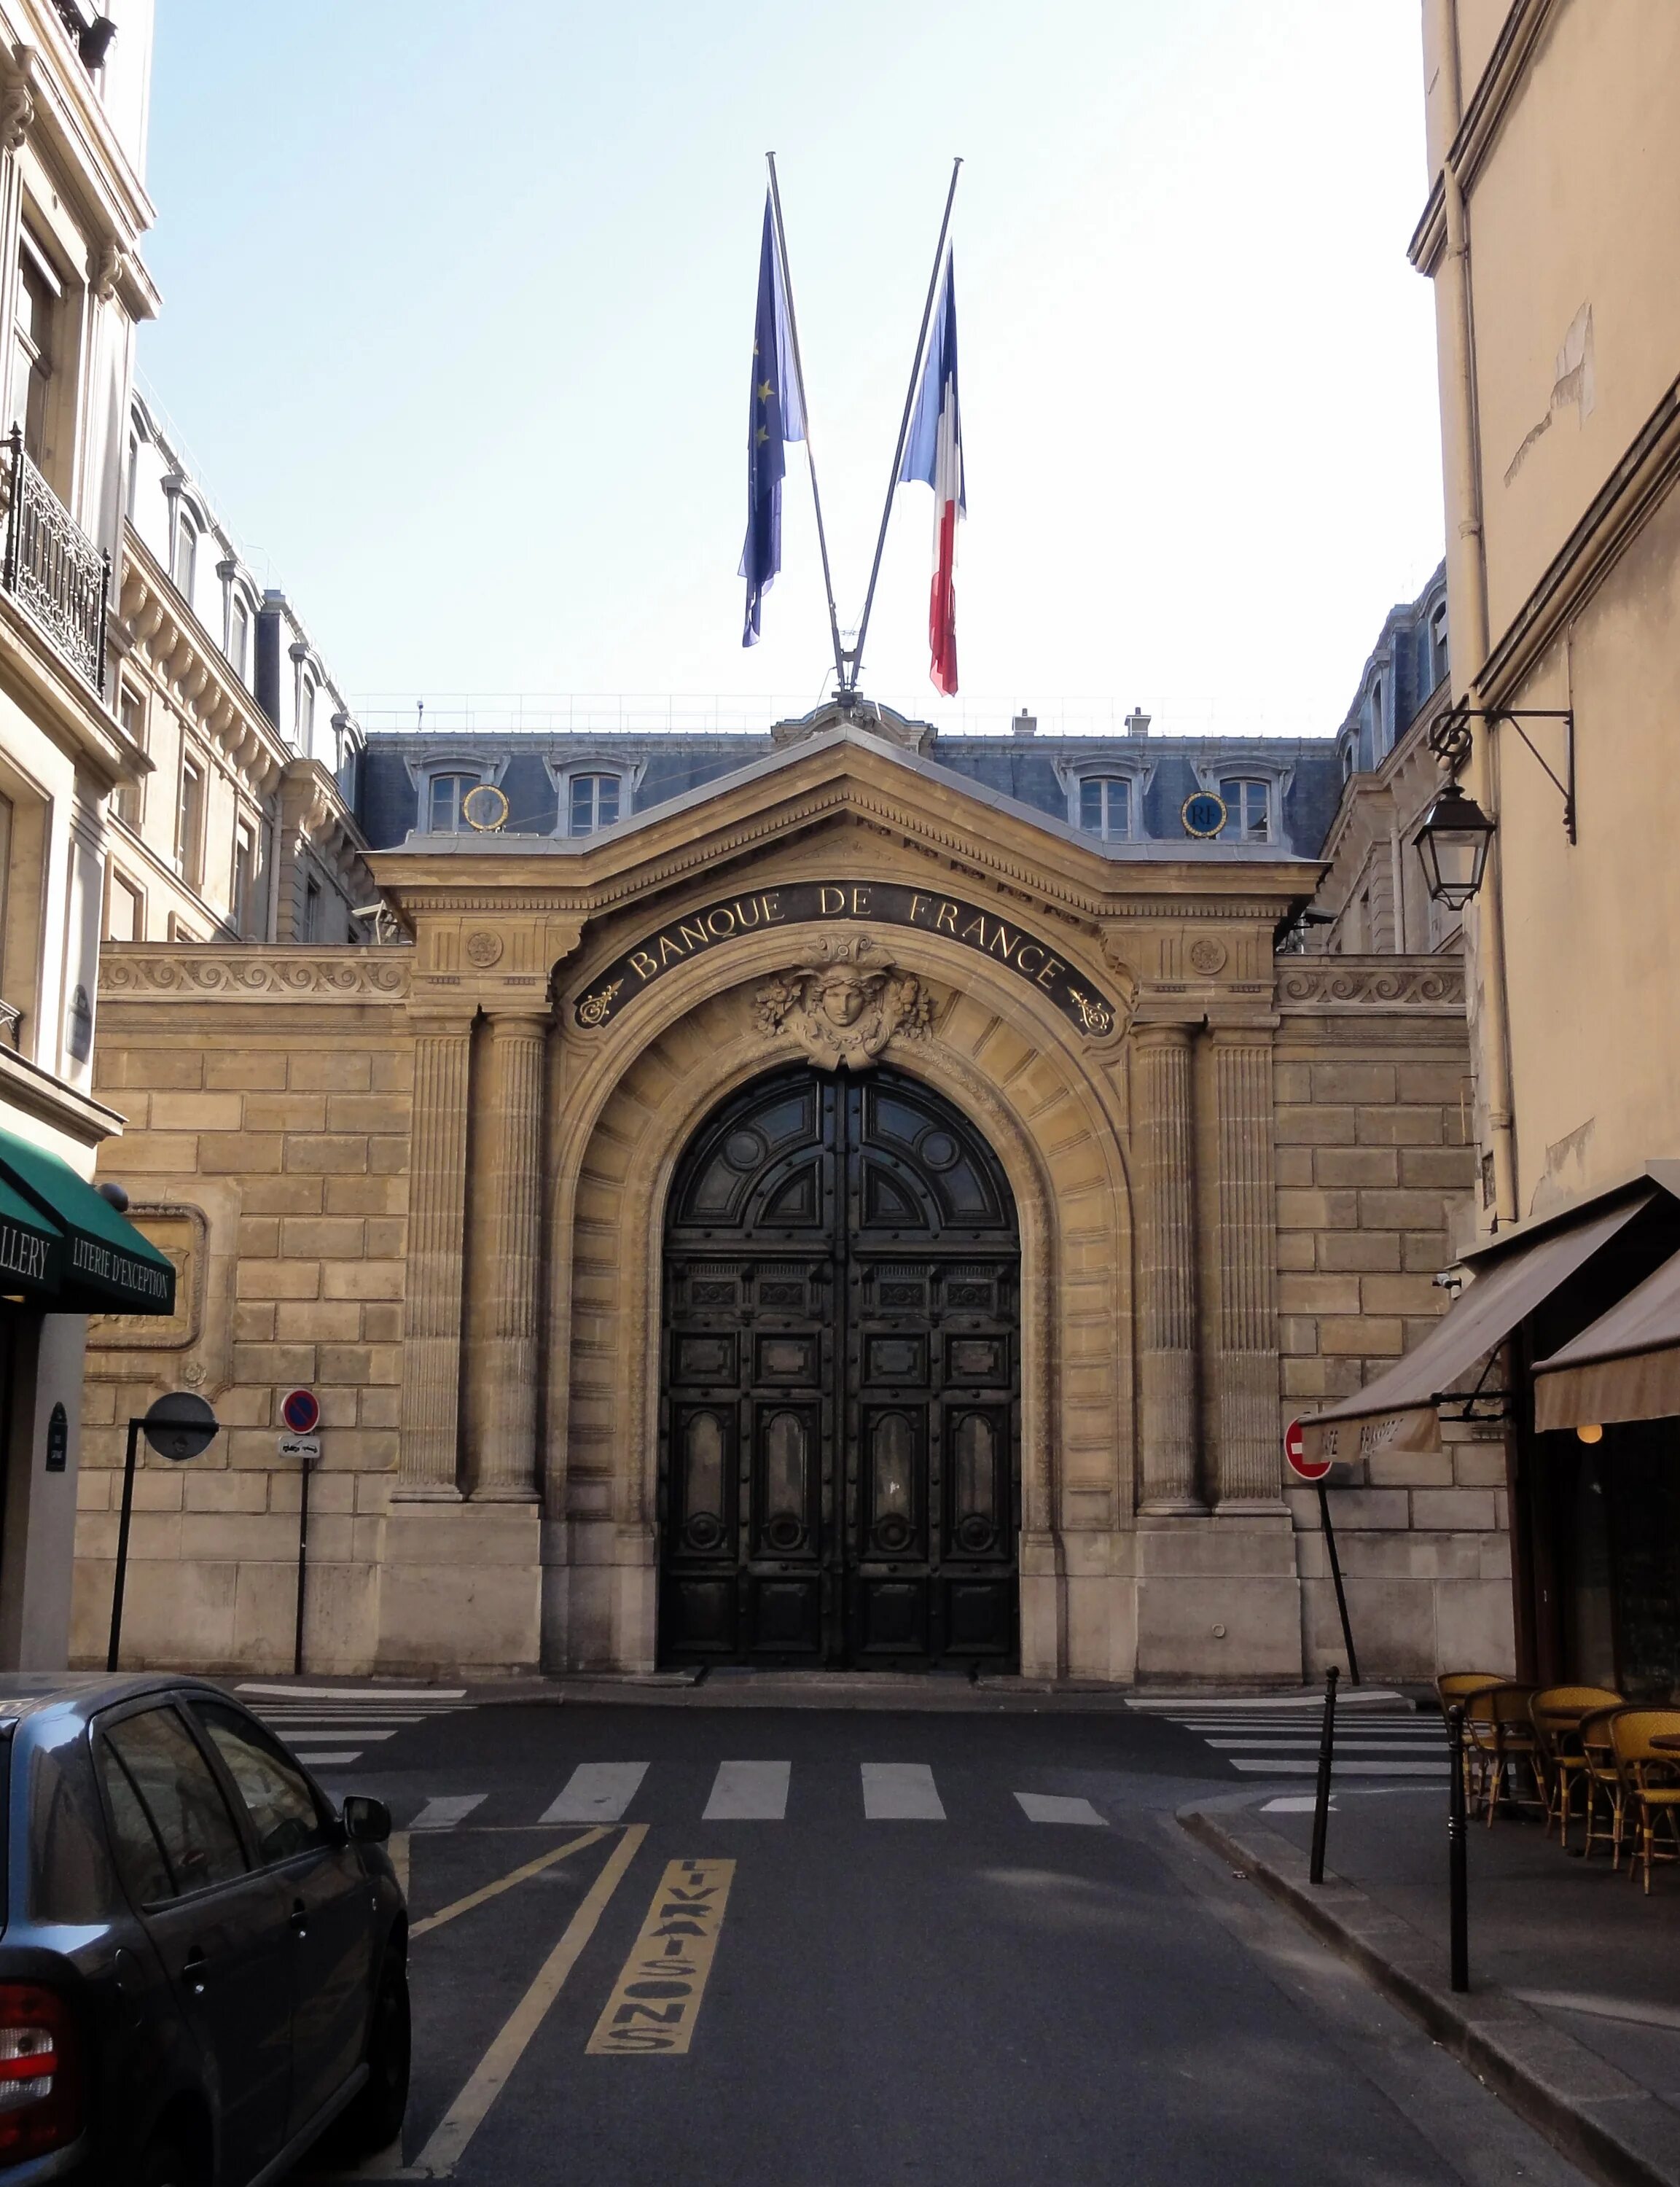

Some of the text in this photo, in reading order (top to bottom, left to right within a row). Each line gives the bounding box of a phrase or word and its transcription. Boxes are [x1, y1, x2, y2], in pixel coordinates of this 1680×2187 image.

[1191, 804, 1217, 824] RF
[628, 887, 1066, 989] BANQUE DE FRANCE
[73, 1237, 168, 1298] LITERIE D'EXCEPTION
